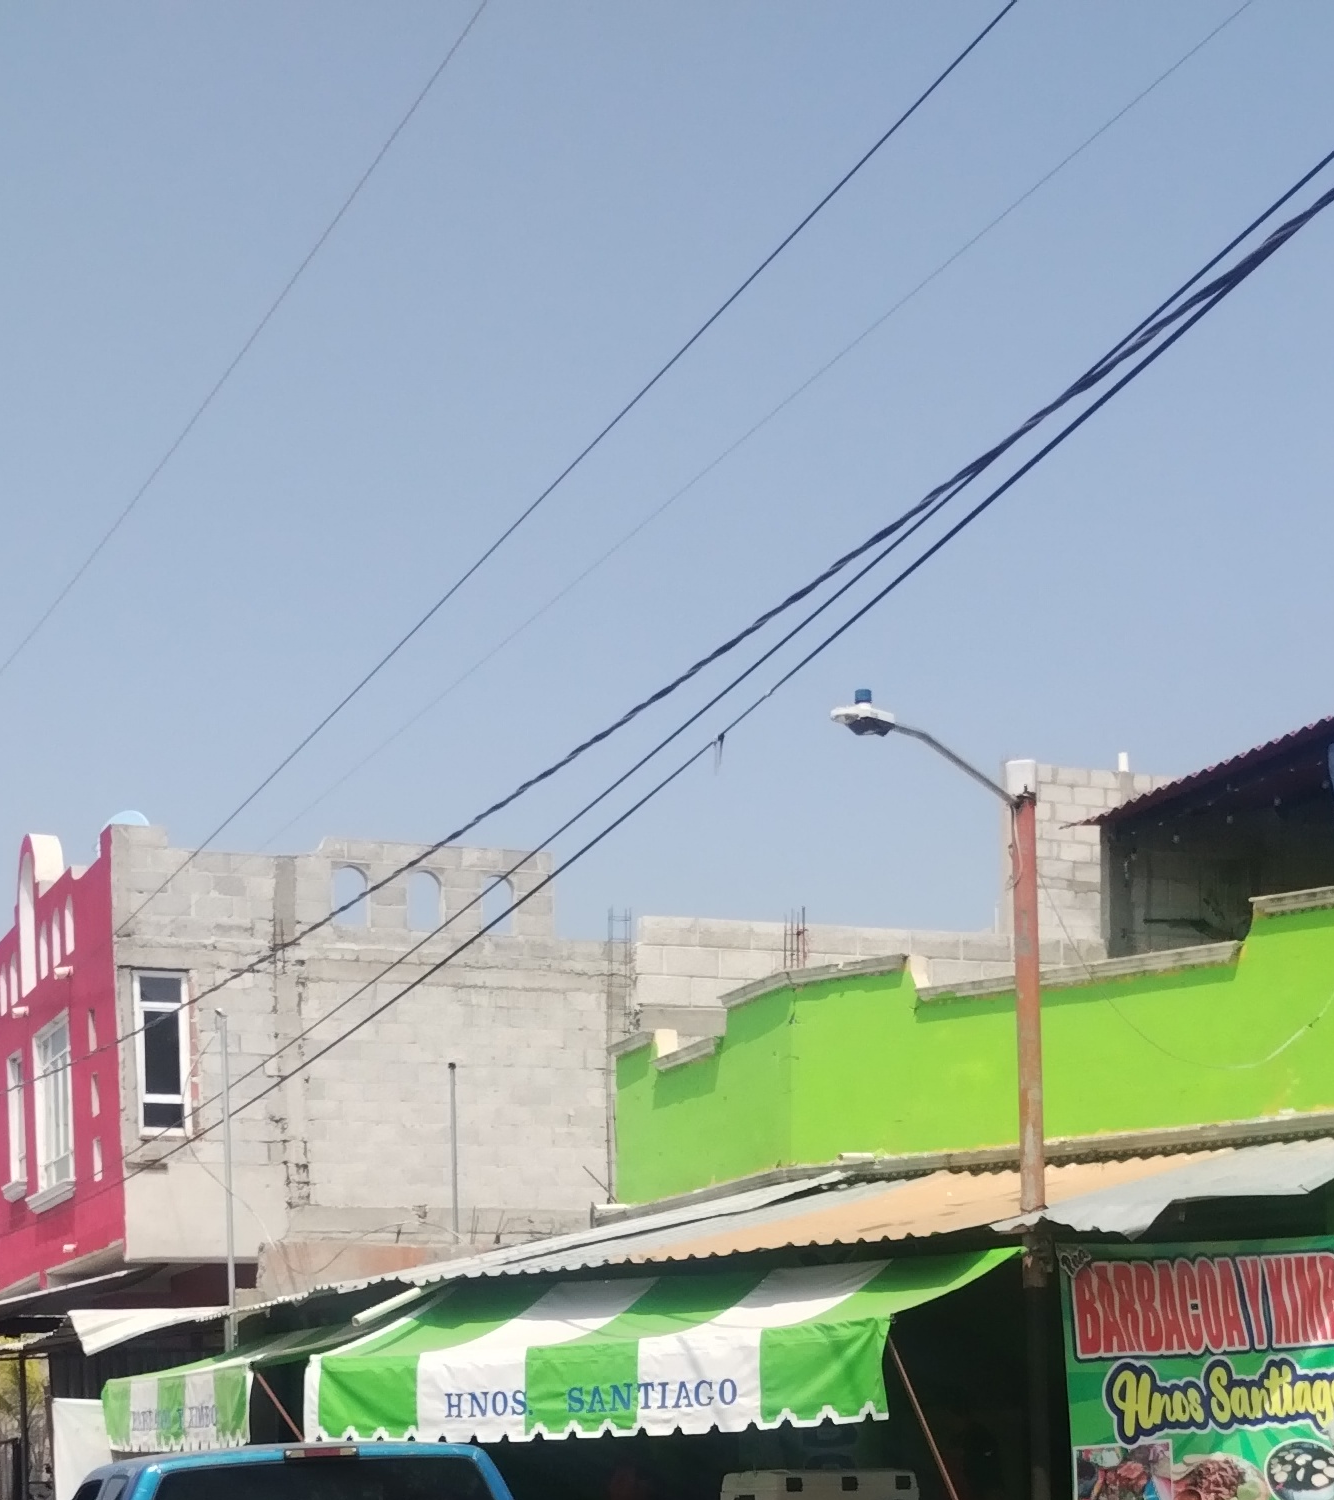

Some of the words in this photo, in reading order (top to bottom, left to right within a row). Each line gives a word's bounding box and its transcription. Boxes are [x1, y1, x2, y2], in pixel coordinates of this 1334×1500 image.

[1074, 1257, 1248, 1356] BARBACOA
[1237, 1256, 1266, 1347] Y
[443, 1389, 534, 1418] HNOS.
[567, 1378, 738, 1414] SANTIAGO
[1112, 1369, 1205, 1437] Hnos
